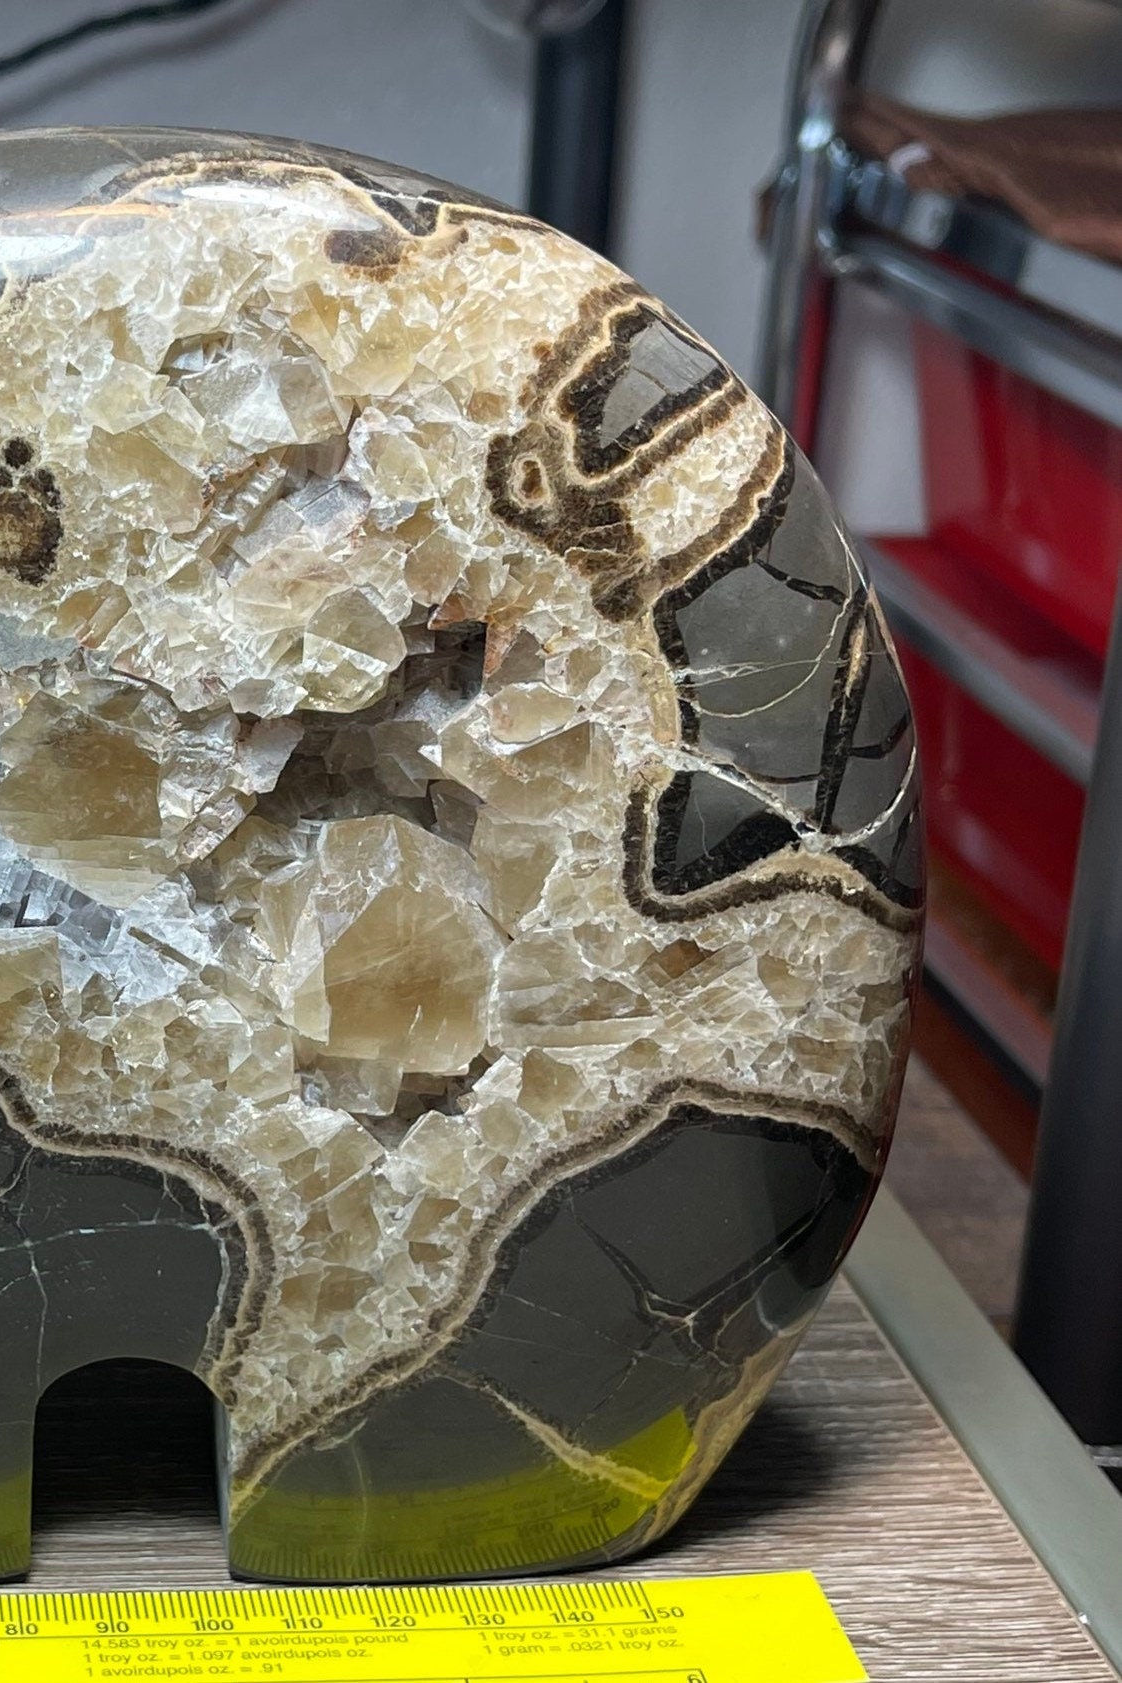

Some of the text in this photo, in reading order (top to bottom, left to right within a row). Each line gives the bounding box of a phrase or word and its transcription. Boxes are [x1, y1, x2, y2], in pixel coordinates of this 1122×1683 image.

[5, 1622, 38, 1636] 80
[95, 1620, 129, 1633] 90
[192, 1618, 234, 1631] 100
[283, 1617, 323, 1629] 110
[371, 1615, 416, 1628] 120
[462, 1613, 505, 1626] 130
[551, 1611, 594, 1623] 140
[639, 1607, 685, 1620] 150
[81, 1638, 141, 1649] 14.583
[146, 1638, 178, 1650] troy
[184, 1638, 210, 1647] oz.
[234, 1637, 241, 1646] 1
[249, 1634, 349, 1647] avoirdupois
[354, 1633, 409, 1645] pound
[478, 1631, 487, 1641] 1
[493, 1630, 526, 1642] troy
[531, 1631, 558, 1640] oz.
[577, 1627, 616, 1638] 31.1
[622, 1626, 678, 1639] grams
[483, 1645, 492, 1654] 1
[499, 1644, 544, 1657] gram
[568, 1641, 613, 1652] .0321
[619, 1640, 651, 1651] troy
[658, 1638, 684, 1648] oz.
[84, 1653, 91, 1663] 1
[99, 1652, 131, 1664] troy
[137, 1653, 163, 1662] oz.
[187, 1650, 234, 1661] 1.097
[241, 1648, 341, 1661] avoirdupois
[346, 1649, 373, 1658] oz.
[86, 1667, 93, 1677] 1
[101, 1665, 203, 1678] avoirdupois
[208, 1665, 234, 1674] oz.
[259, 1663, 283, 1674] .91
